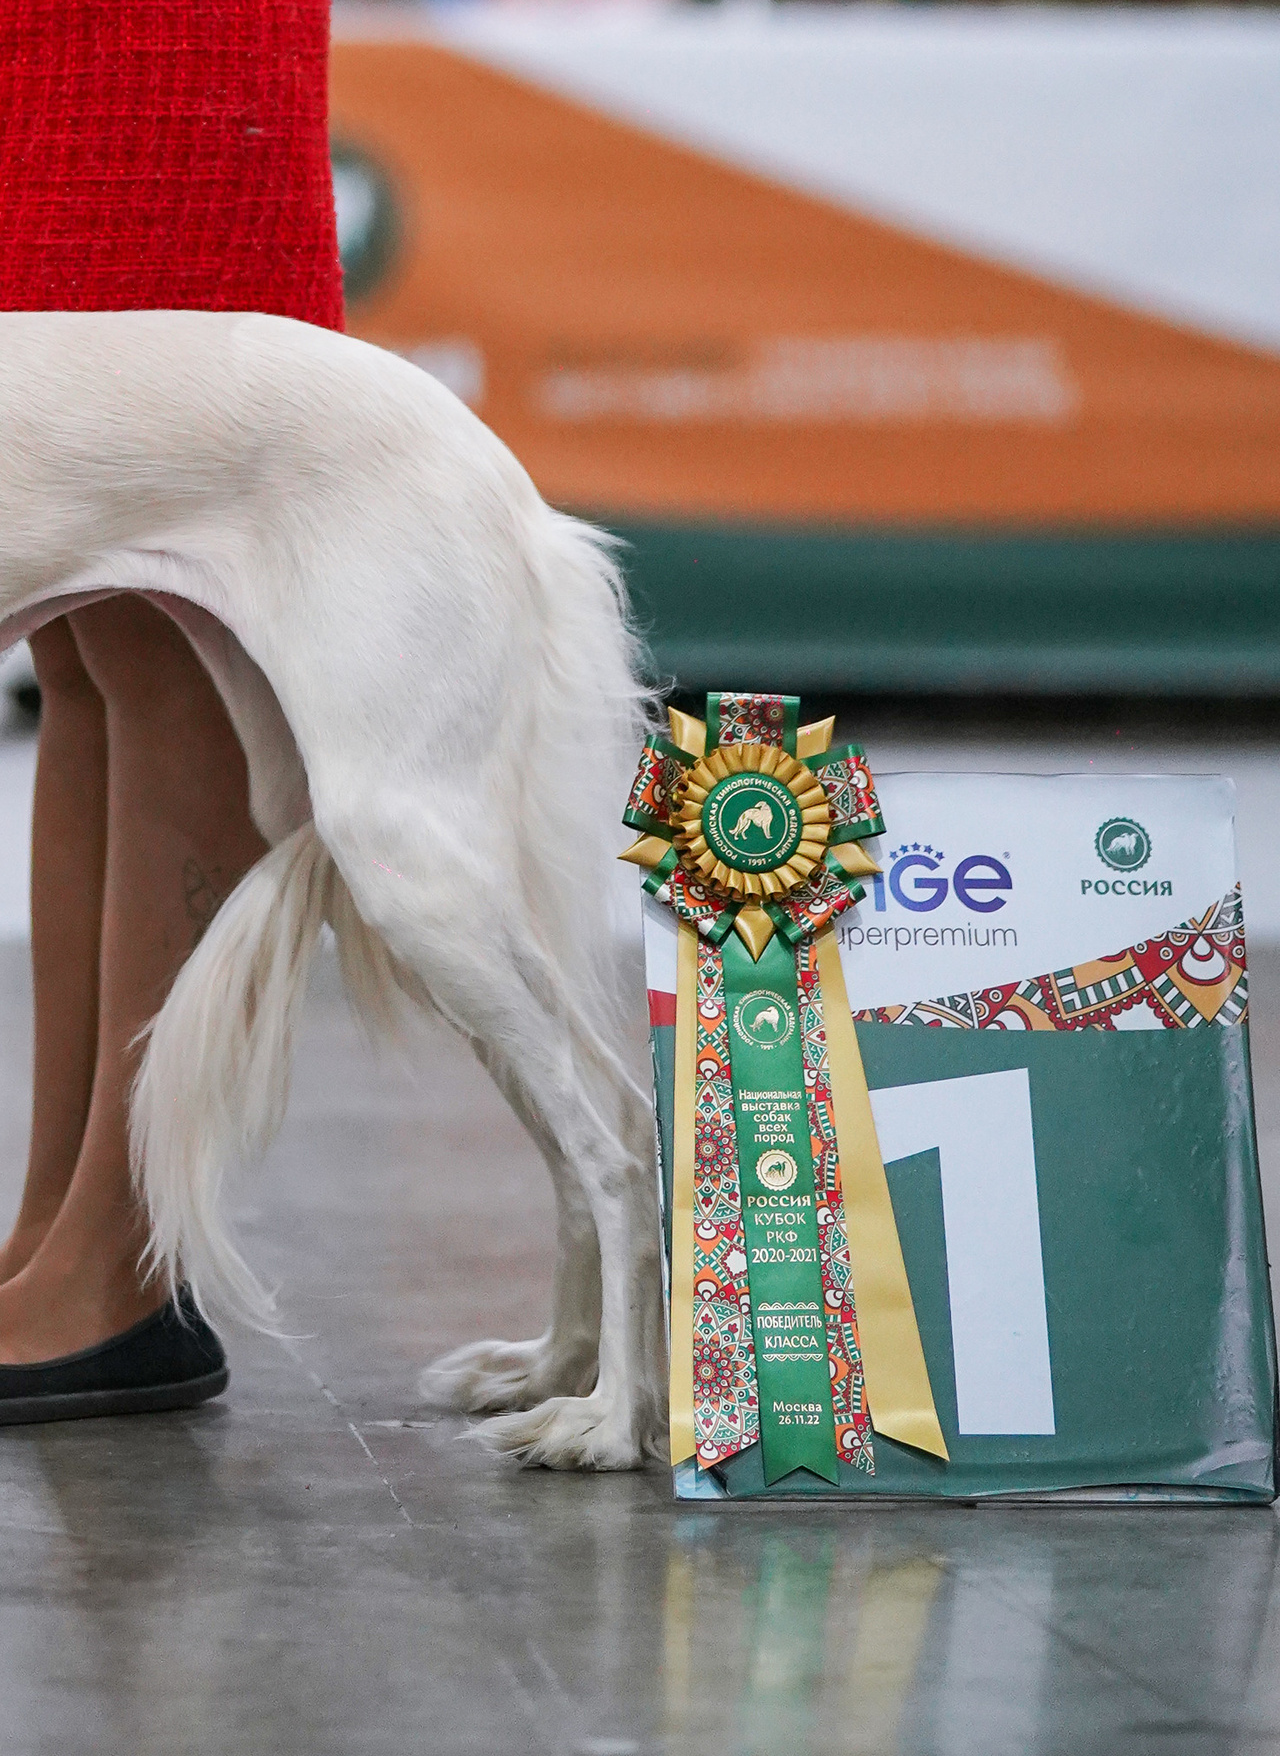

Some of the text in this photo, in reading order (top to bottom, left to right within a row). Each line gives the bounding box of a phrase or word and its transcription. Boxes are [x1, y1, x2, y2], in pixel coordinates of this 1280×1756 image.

[716, 778, 792, 806] КИНОЛОГИЧЕСКАЯ
[748, 858, 767, 866] 1991
[1080, 878, 1173, 897] РОССИЯ
[739, 1089, 802, 1102] Национальная
[741, 1102, 801, 1112] выставка
[753, 1110, 792, 1122] собак
[759, 1123, 788, 1132] всех
[754, 1133, 795, 1144] пород
[747, 1195, 812, 1208] РОССИЯ
[754, 1212, 807, 1225] КУБОК
[766, 1230, 799, 1243] РКФ
[751, 1248, 818, 1263] 2020-2021
[868, 1068, 1056, 1435] 1
[756, 1315, 822, 1330] ПОБЕДИТЕЛЬ
[764, 1335, 819, 1348] КЛАССА
[773, 1401, 822, 1412] Москва
[778, 1415, 820, 1425] 26.11.22
